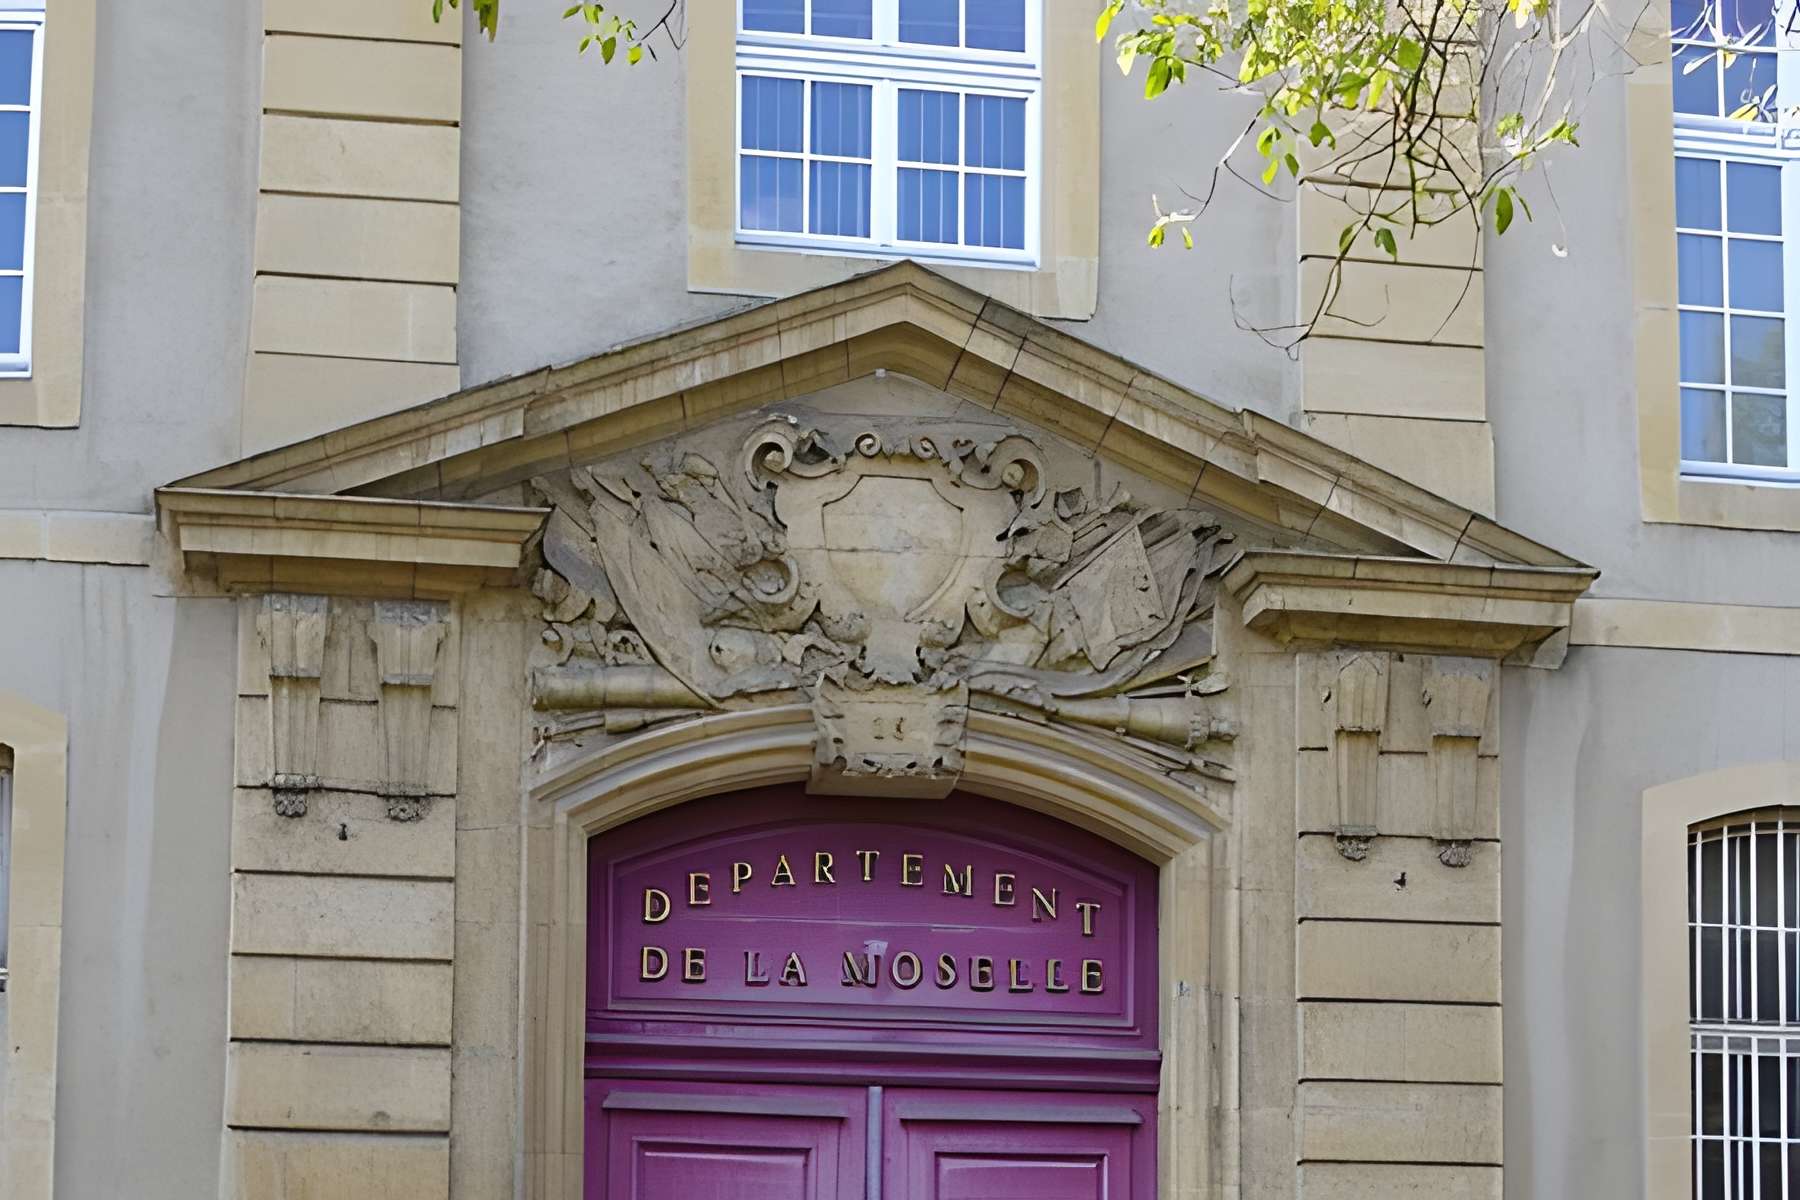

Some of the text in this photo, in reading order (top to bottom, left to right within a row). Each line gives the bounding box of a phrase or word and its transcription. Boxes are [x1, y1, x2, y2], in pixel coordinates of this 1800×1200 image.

[644, 850, 1101, 936] DEPARTEMENT
[641, 947, 1104, 992] DE LA MOSELLE
